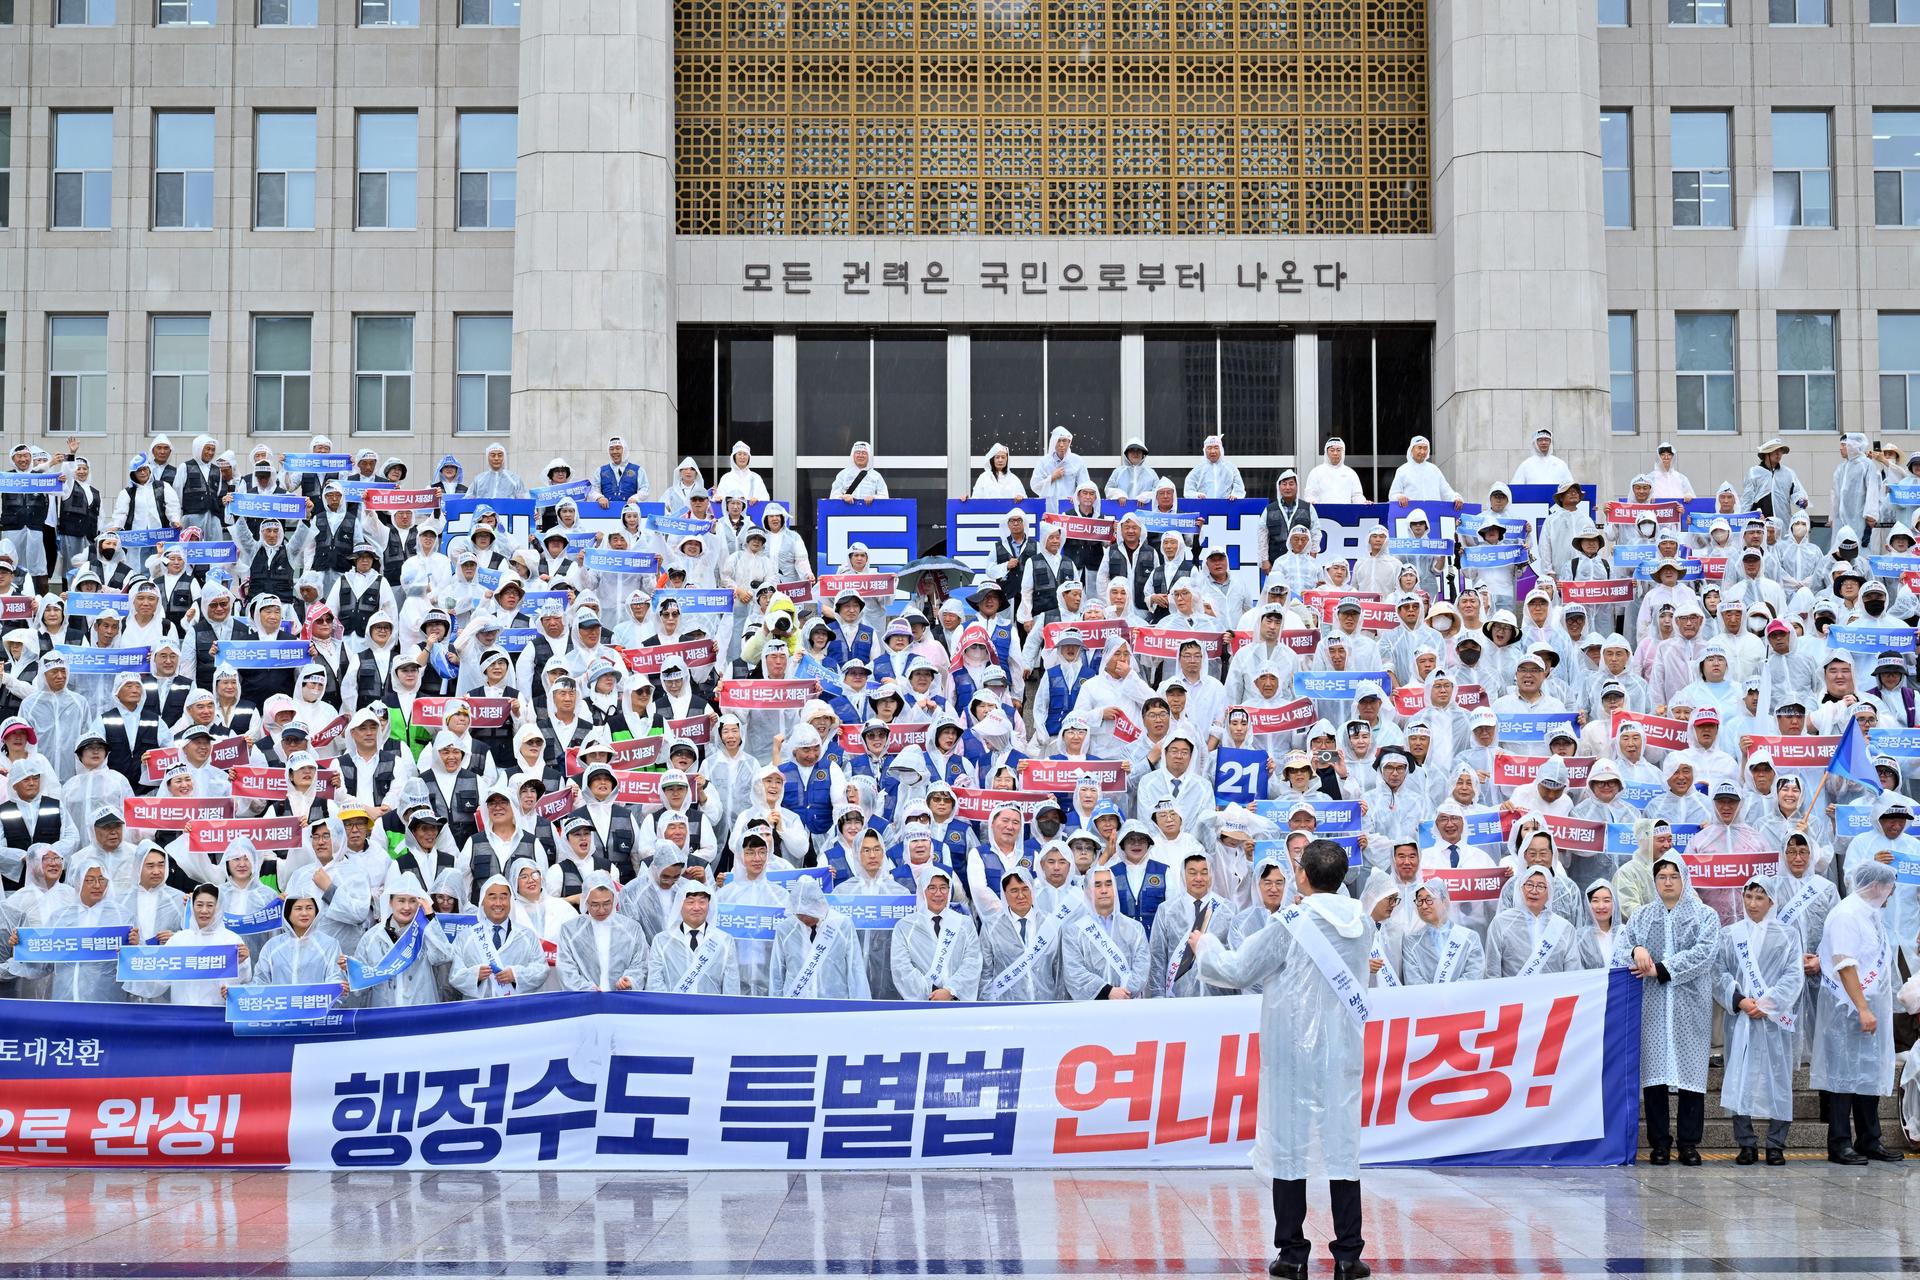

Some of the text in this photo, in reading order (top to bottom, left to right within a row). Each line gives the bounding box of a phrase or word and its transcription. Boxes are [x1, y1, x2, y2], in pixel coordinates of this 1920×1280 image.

[743, 260, 1348, 294] 모든 권력은 국민으로부터 나온다
[290, 458, 320, 468] 행정수도
[30, 477, 57, 487] 특별법!
[371, 493, 433, 505] 연내 반드시 제정!
[237, 501, 300, 513] 행정수도 특별법!
[1614, 509, 1630, 518] 연내
[1655, 508, 1674, 518] 제정!
[1068, 522, 1092, 534] 반드시
[1092, 524, 1111, 536] 제정!
[1421, 539, 1448, 550] 특별법!
[205, 547, 230, 558] 특별법!
[1621, 551, 1654, 561] 행정수도
[590, 555, 623, 567] 행정수도
[826, 581, 843, 591] 연내
[869, 580, 889, 591] 제정!
[1569, 586, 1628, 598] 연내 반드시 제정!
[5, 602, 26, 613] 제정!
[75, 599, 108, 611] 행정수도
[697, 596, 728, 607] 특별법!
[1143, 636, 1162, 649] 연내
[1291, 635, 1313, 648] 제정!
[1836, 631, 1913, 647] 행정수도 특별법!
[108, 654, 143, 666] 특별법!
[225, 648, 305, 661] 행정수도 특별법!
[632, 656, 655, 667] 연내
[685, 647, 709, 660] 제정!
[1304, 679, 1346, 691] 행정수도
[729, 687, 811, 702] 연내 반드시 제정!
[1402, 692, 1480, 708] 연내 제정!
[478, 706, 503, 719] 제정!
[1260, 704, 1314, 726] 반드시 제정!
[680, 723, 705, 737] 제정!
[1116, 718, 1134, 736] 연내
[1499, 721, 1533, 734] 정수도
[214, 746, 239, 763] 제정!
[631, 745, 655, 760] 제정!
[1781, 745, 1815, 758] 반드시
[1032, 769, 1054, 783] 연내
[1217, 762, 1260, 793] 21
[1503, 764, 1525, 778] 연내
[244, 776, 264, 790] 연내
[544, 799, 568, 815] 제정!
[959, 796, 980, 811] 연내
[134, 806, 225, 821] 연내 반드시 제정!
[199, 829, 224, 844] 연내
[264, 826, 293, 841] 제정!
[1567, 828, 1596, 843] 제정!
[1687, 863, 1711, 878] 연내
[1713, 864, 1749, 878] 반드시
[1474, 877, 1500, 890] 제정!
[242, 905, 282, 925] 특별법!
[28, 936, 123, 952] 행정수도 특별법!
[130, 955, 227, 971] 행정수도 특별법!
[238, 994, 333, 1012] 행정수도 특별법!
[331, 1055, 696, 1168] 행정수도
[720, 1047, 1026, 1160] 특별법
[1052, 1032, 1259, 1155] 연내
[89, 1094, 242, 1156] 완성!
